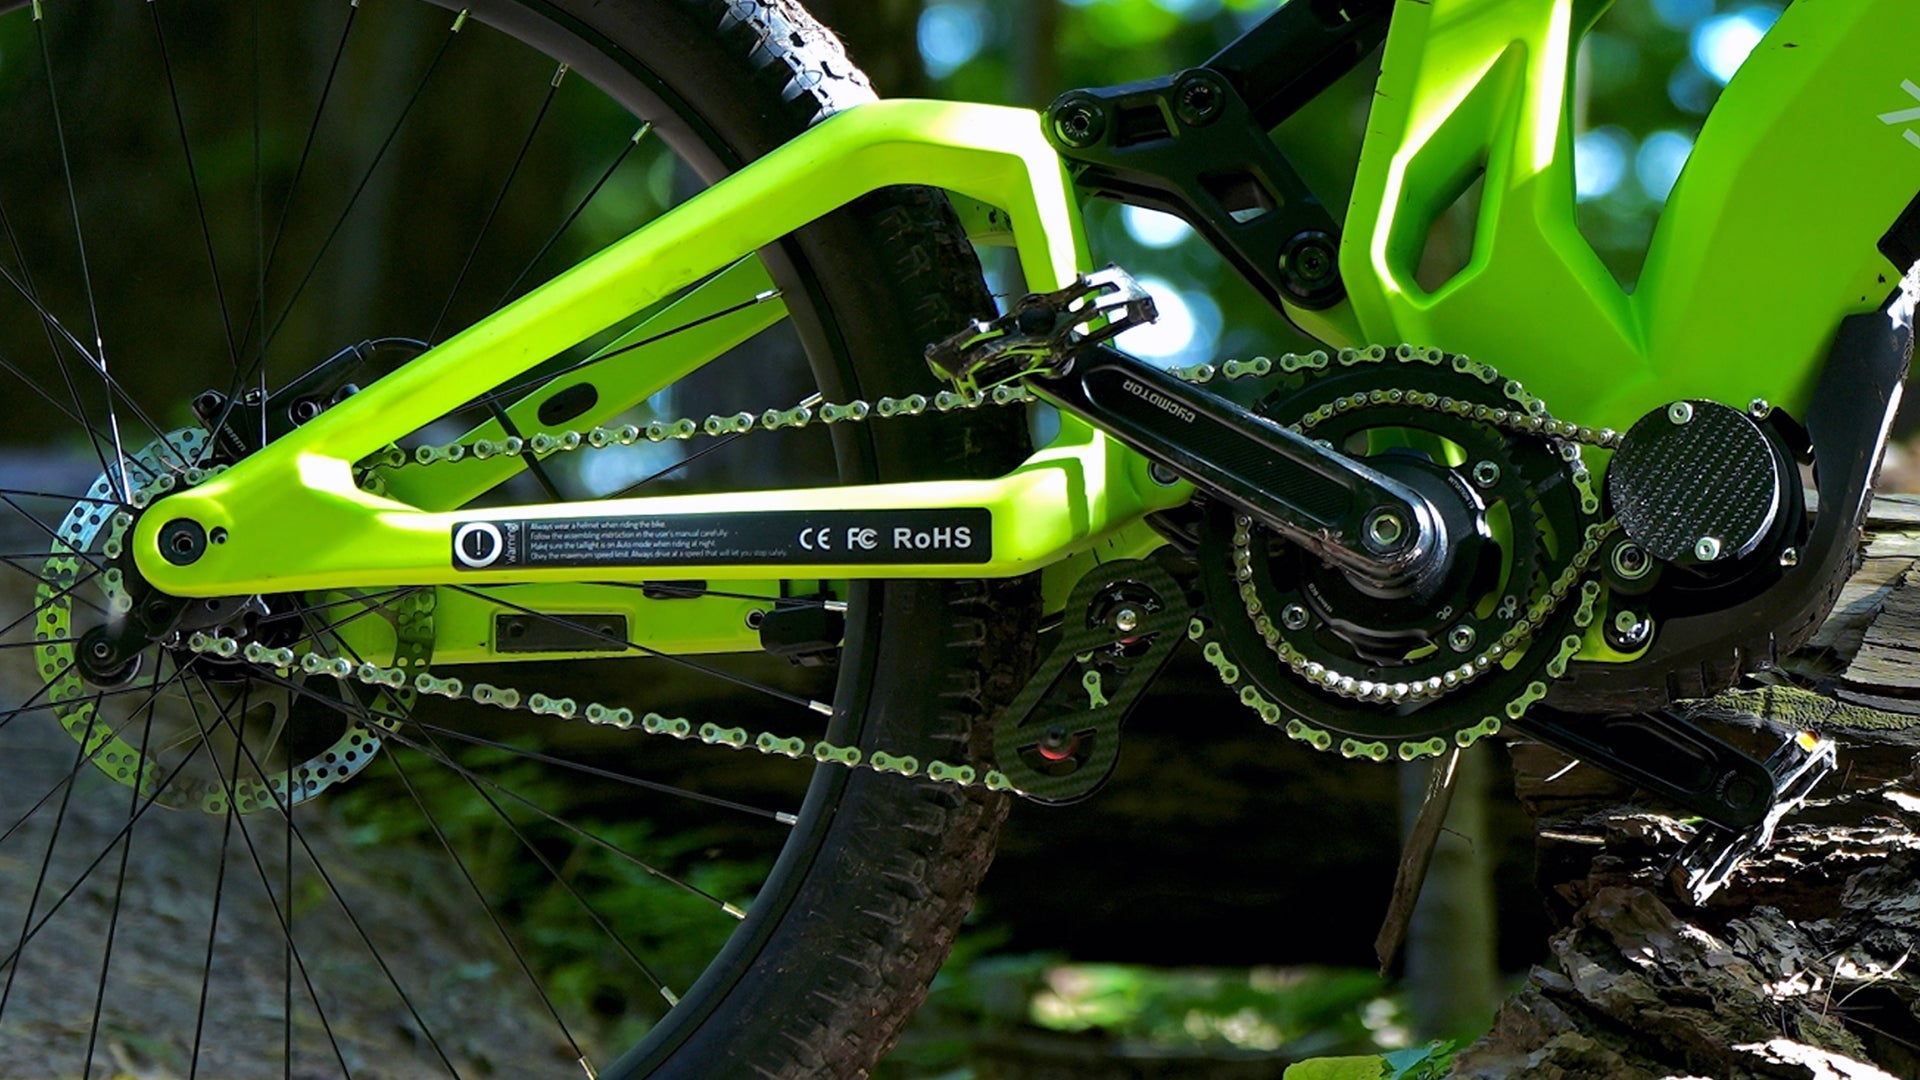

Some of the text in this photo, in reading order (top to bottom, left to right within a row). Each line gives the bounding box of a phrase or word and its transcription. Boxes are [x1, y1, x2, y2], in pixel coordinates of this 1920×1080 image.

[1122, 379, 1196, 424] CYCMOTOR
[530, 522, 553, 531] Always
[576, 521, 599, 529] helmet
[600, 521, 618, 529] when
[619, 520, 639, 530] riding
[639, 520, 651, 529] the
[530, 531, 551, 540] Follow
[552, 531, 563, 540] the
[564, 531, 600, 541] assembling
[600, 530, 633, 539] instruction
[643, 530, 654, 538] the
[674, 529, 700, 538] manual
[893, 526, 972, 549] RoHS
[504, 522, 519, 565] Warning
[530, 542, 548, 551] Make
[563, 541, 576, 550] the
[616, 540, 632, 549] Auto
[632, 540, 651, 548] mode
[671, 539, 691, 549] riding
[548, 552, 560, 560] the
[560, 552, 593, 560] maximum
[594, 551, 614, 560] speed
[631, 550, 653, 559] Always
[654, 550, 670, 558] drive
[684, 549, 704, 559] speed
[705, 549, 718, 557] that
